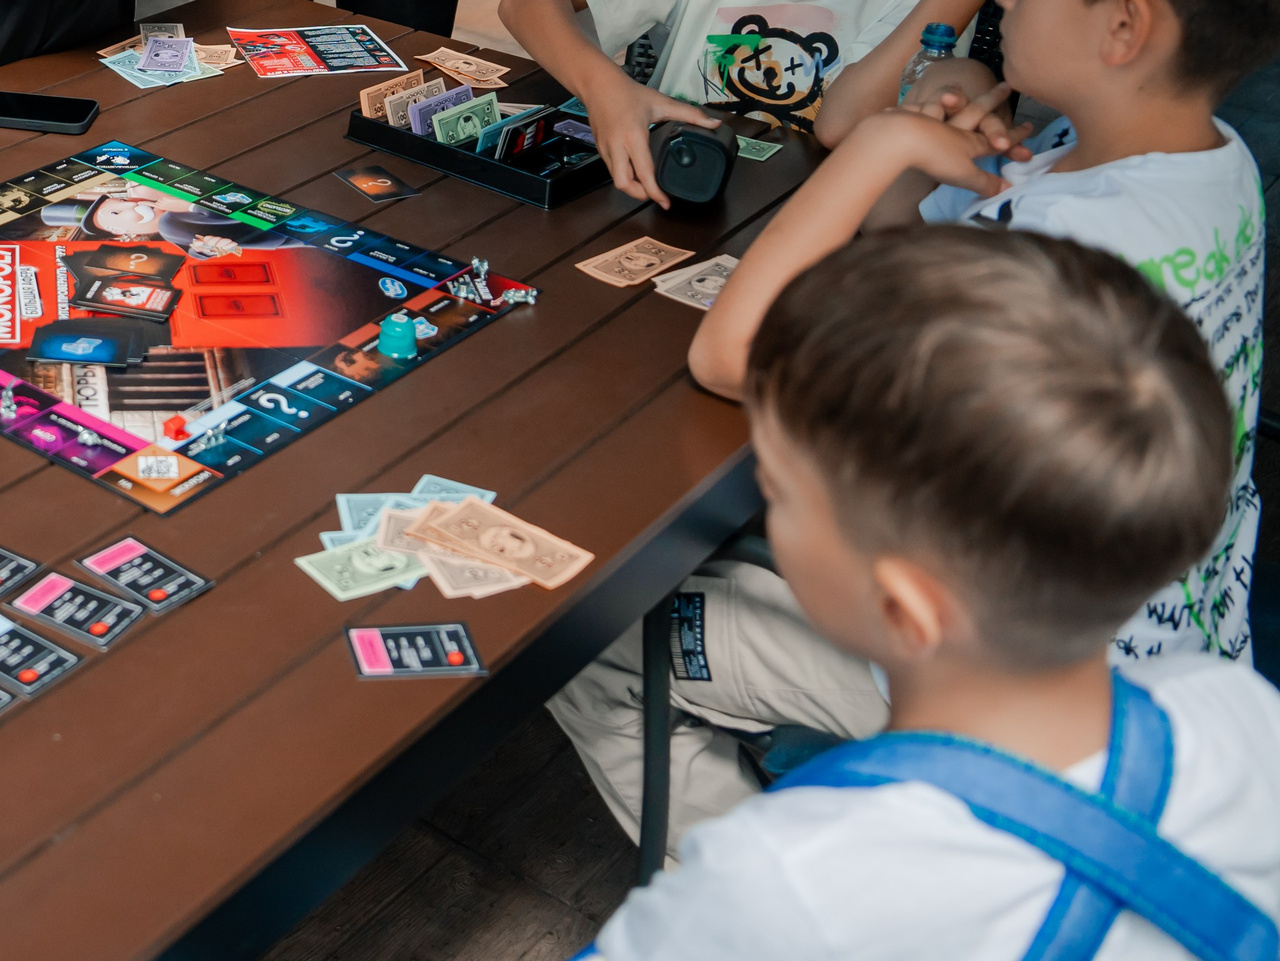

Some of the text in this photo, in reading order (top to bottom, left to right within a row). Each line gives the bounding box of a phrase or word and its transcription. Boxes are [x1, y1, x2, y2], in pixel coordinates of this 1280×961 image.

[384, 81, 406, 91] MONOPOLY
[406, 89, 426, 99] MONOPOLY
[434, 95, 455, 107] MONOPOLY
[373, 105, 384, 115] 500
[397, 113, 408, 121] 100
[19, 267, 39, 315] БОЛЬШАЯ АФЕРА
